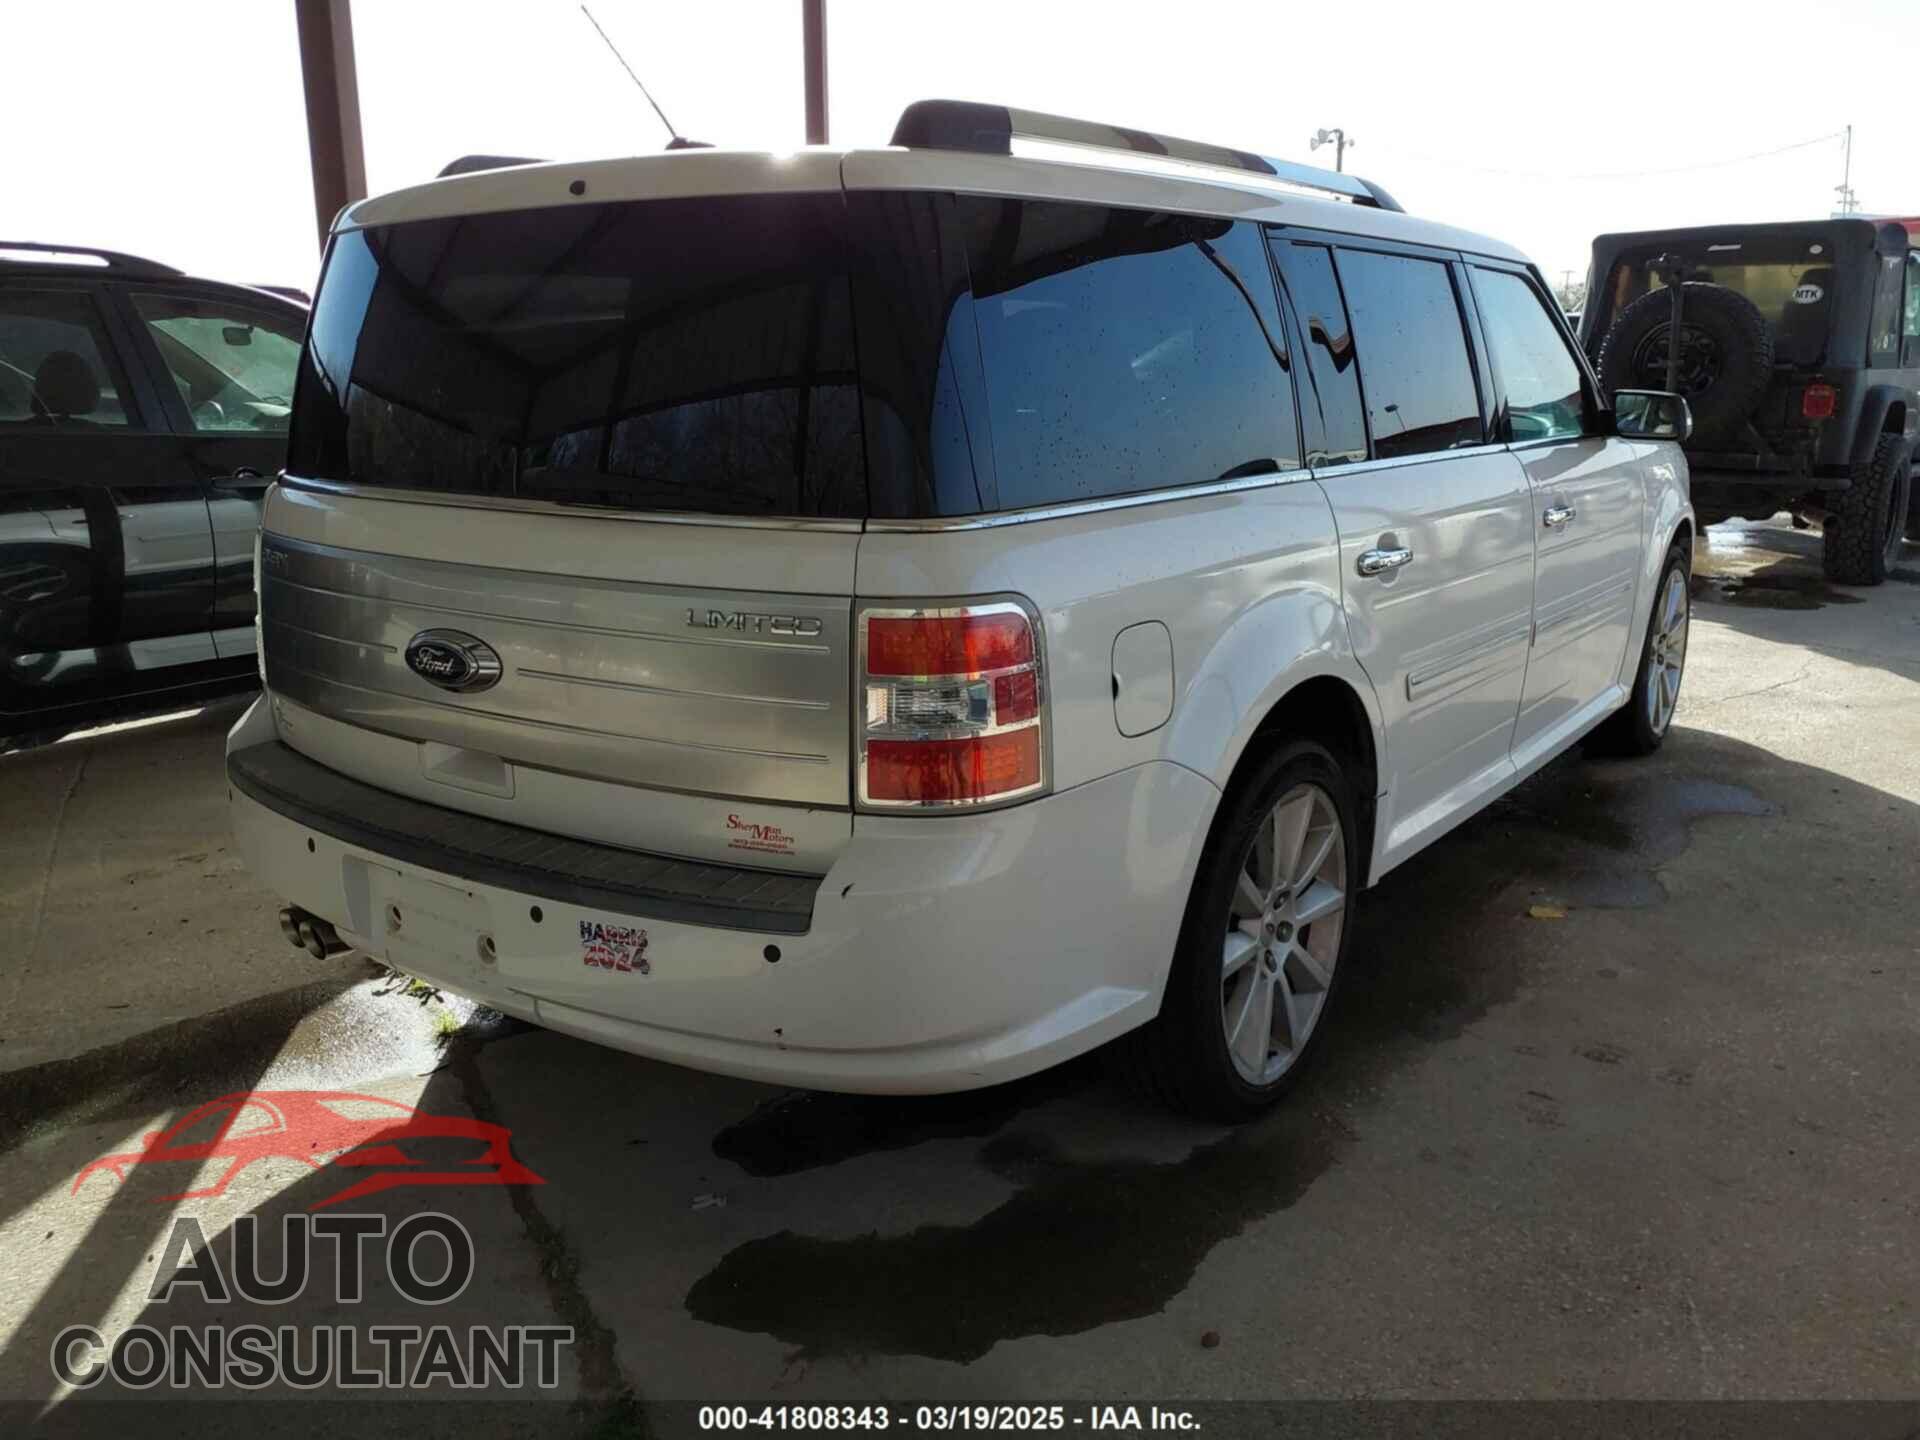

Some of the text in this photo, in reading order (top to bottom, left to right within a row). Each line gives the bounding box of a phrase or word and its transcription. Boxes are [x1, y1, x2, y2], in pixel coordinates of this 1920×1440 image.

[686, 607, 823, 636] LIMITED
[415, 646, 456, 675] Ford
[579, 920, 649, 948] HARRIS
[583, 945, 650, 975] 2024
